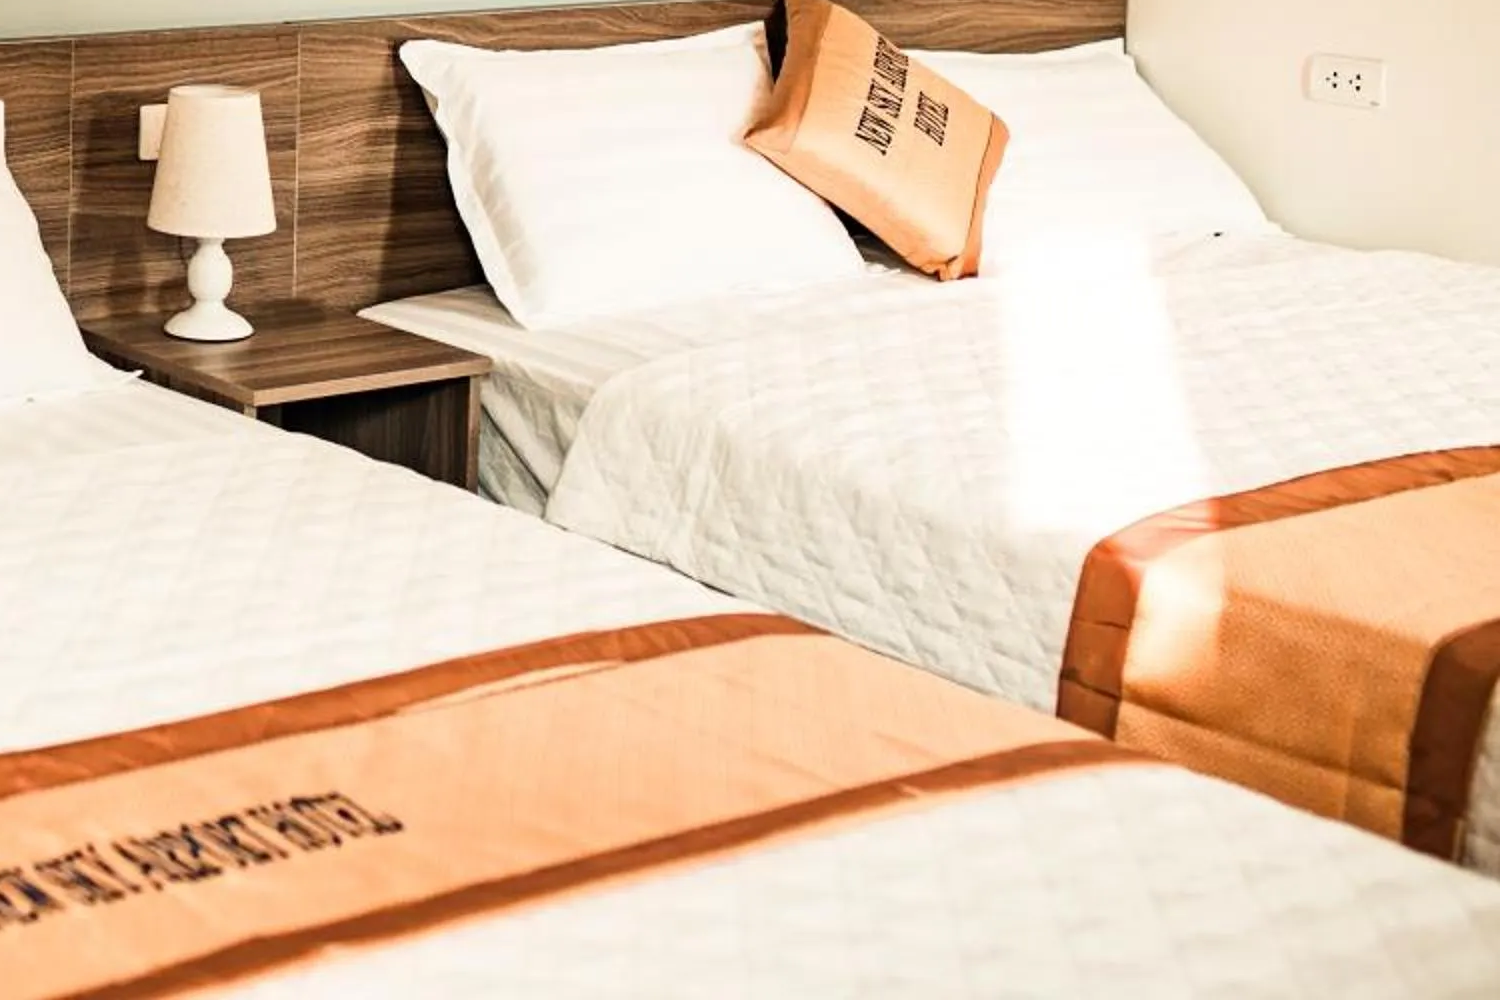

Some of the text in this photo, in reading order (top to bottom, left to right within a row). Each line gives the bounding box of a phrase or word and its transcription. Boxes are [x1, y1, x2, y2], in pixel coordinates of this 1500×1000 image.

[854, 105, 897, 156] NEW
[913, 90, 949, 147] HOTEL
[244, 791, 405, 852] HOTEL
